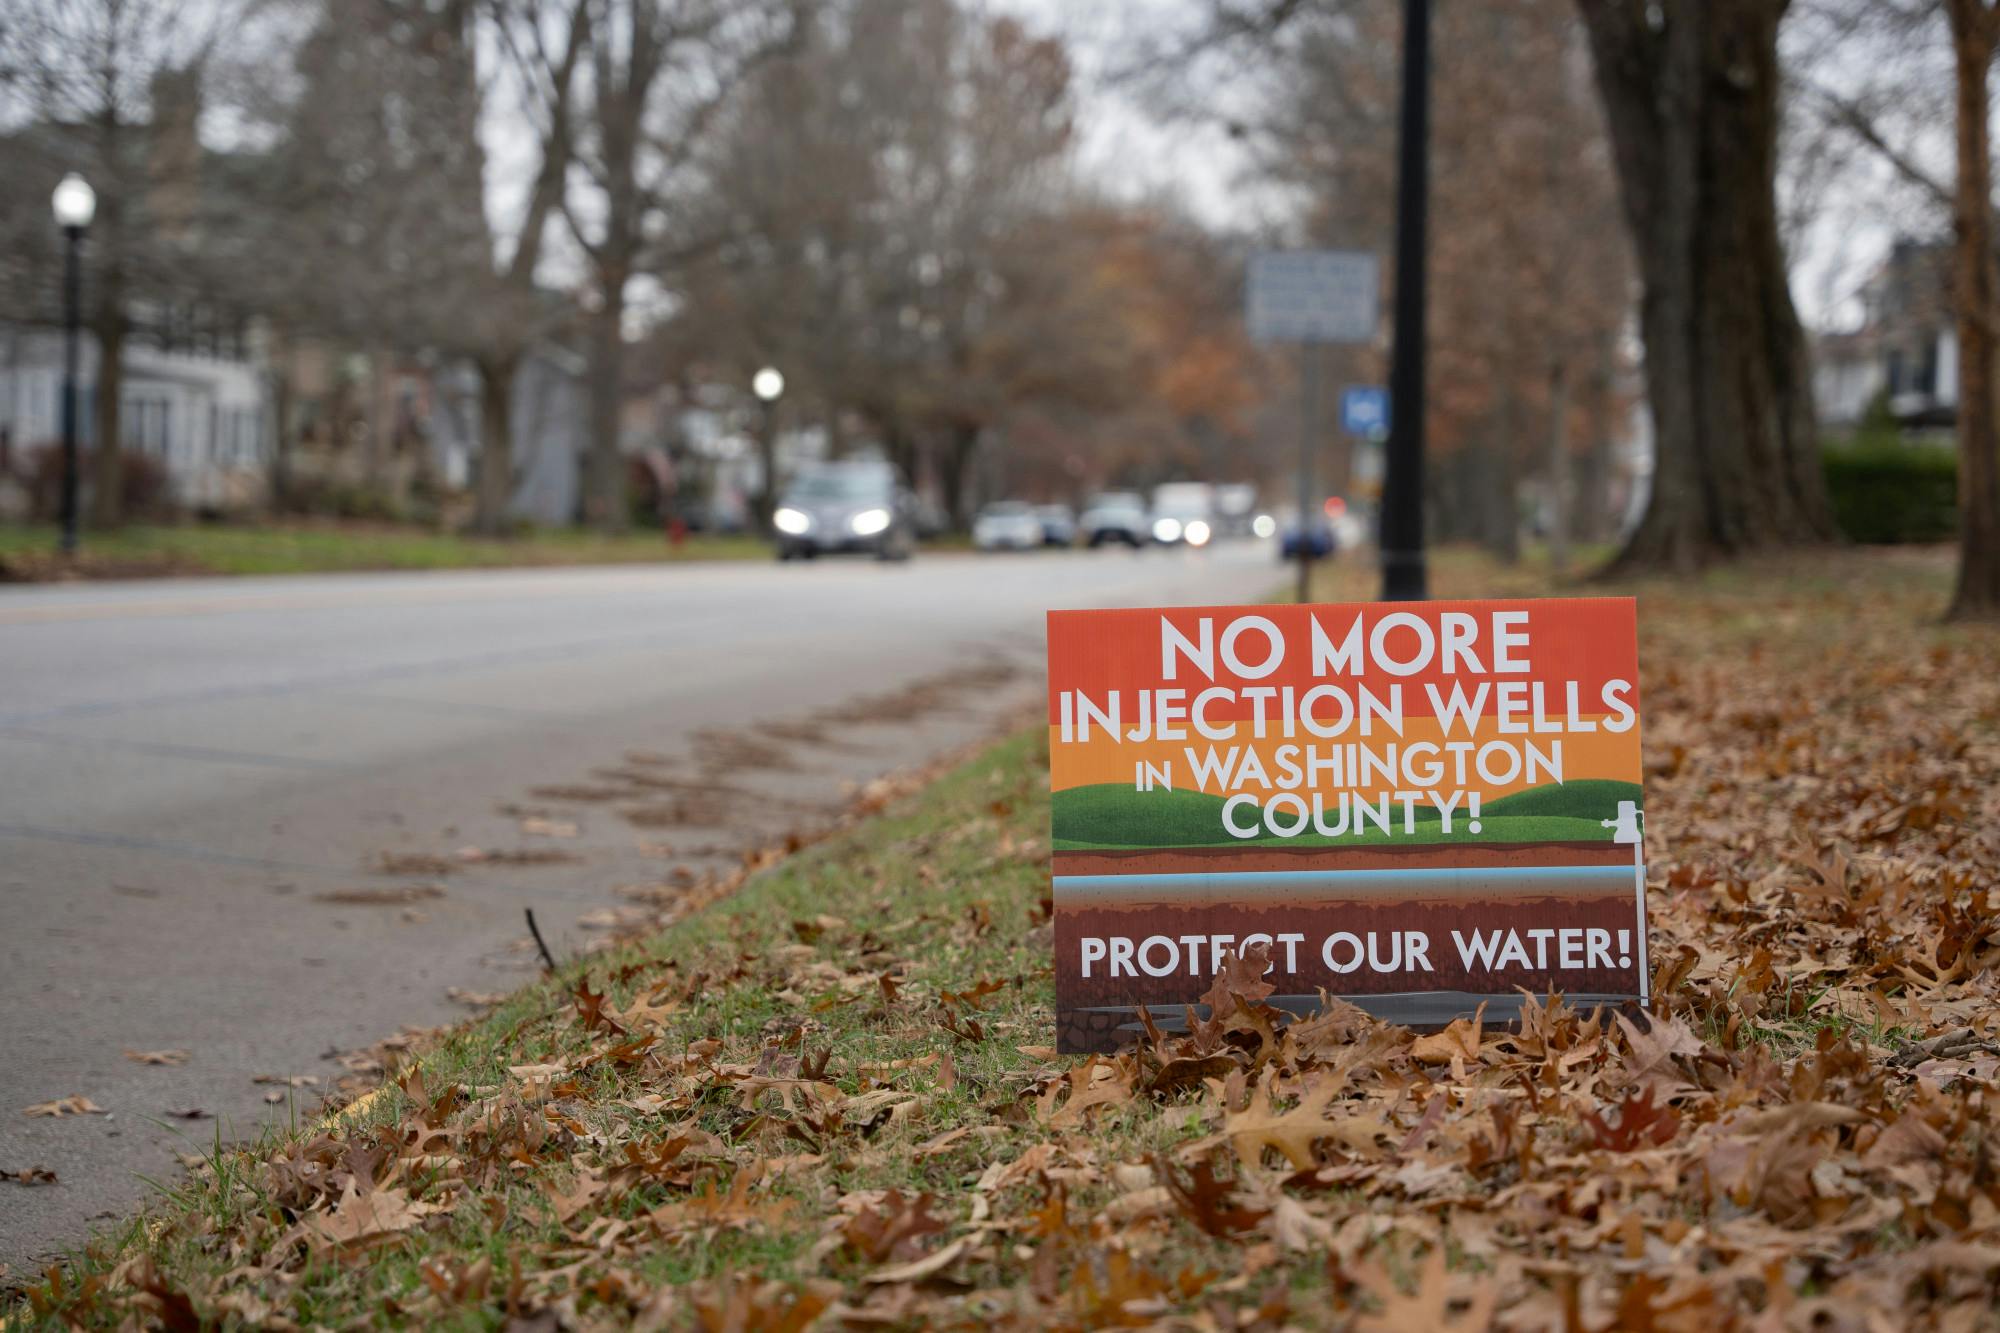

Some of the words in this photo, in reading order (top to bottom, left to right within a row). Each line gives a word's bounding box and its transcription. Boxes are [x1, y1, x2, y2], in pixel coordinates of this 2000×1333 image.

[1161, 611, 1286, 682] NO
[1310, 610, 1531, 677] MORE
[1060, 681, 1404, 745] INJECTION
[1423, 678, 1636, 738] WELLS
[1135, 759, 1172, 793] IN
[1183, 738, 1563, 793] WASHINGTON
[1221, 790, 1482, 839] COUNTY!
[1321, 931, 1435, 974] OUR
[1450, 927, 1632, 973] WATER!
